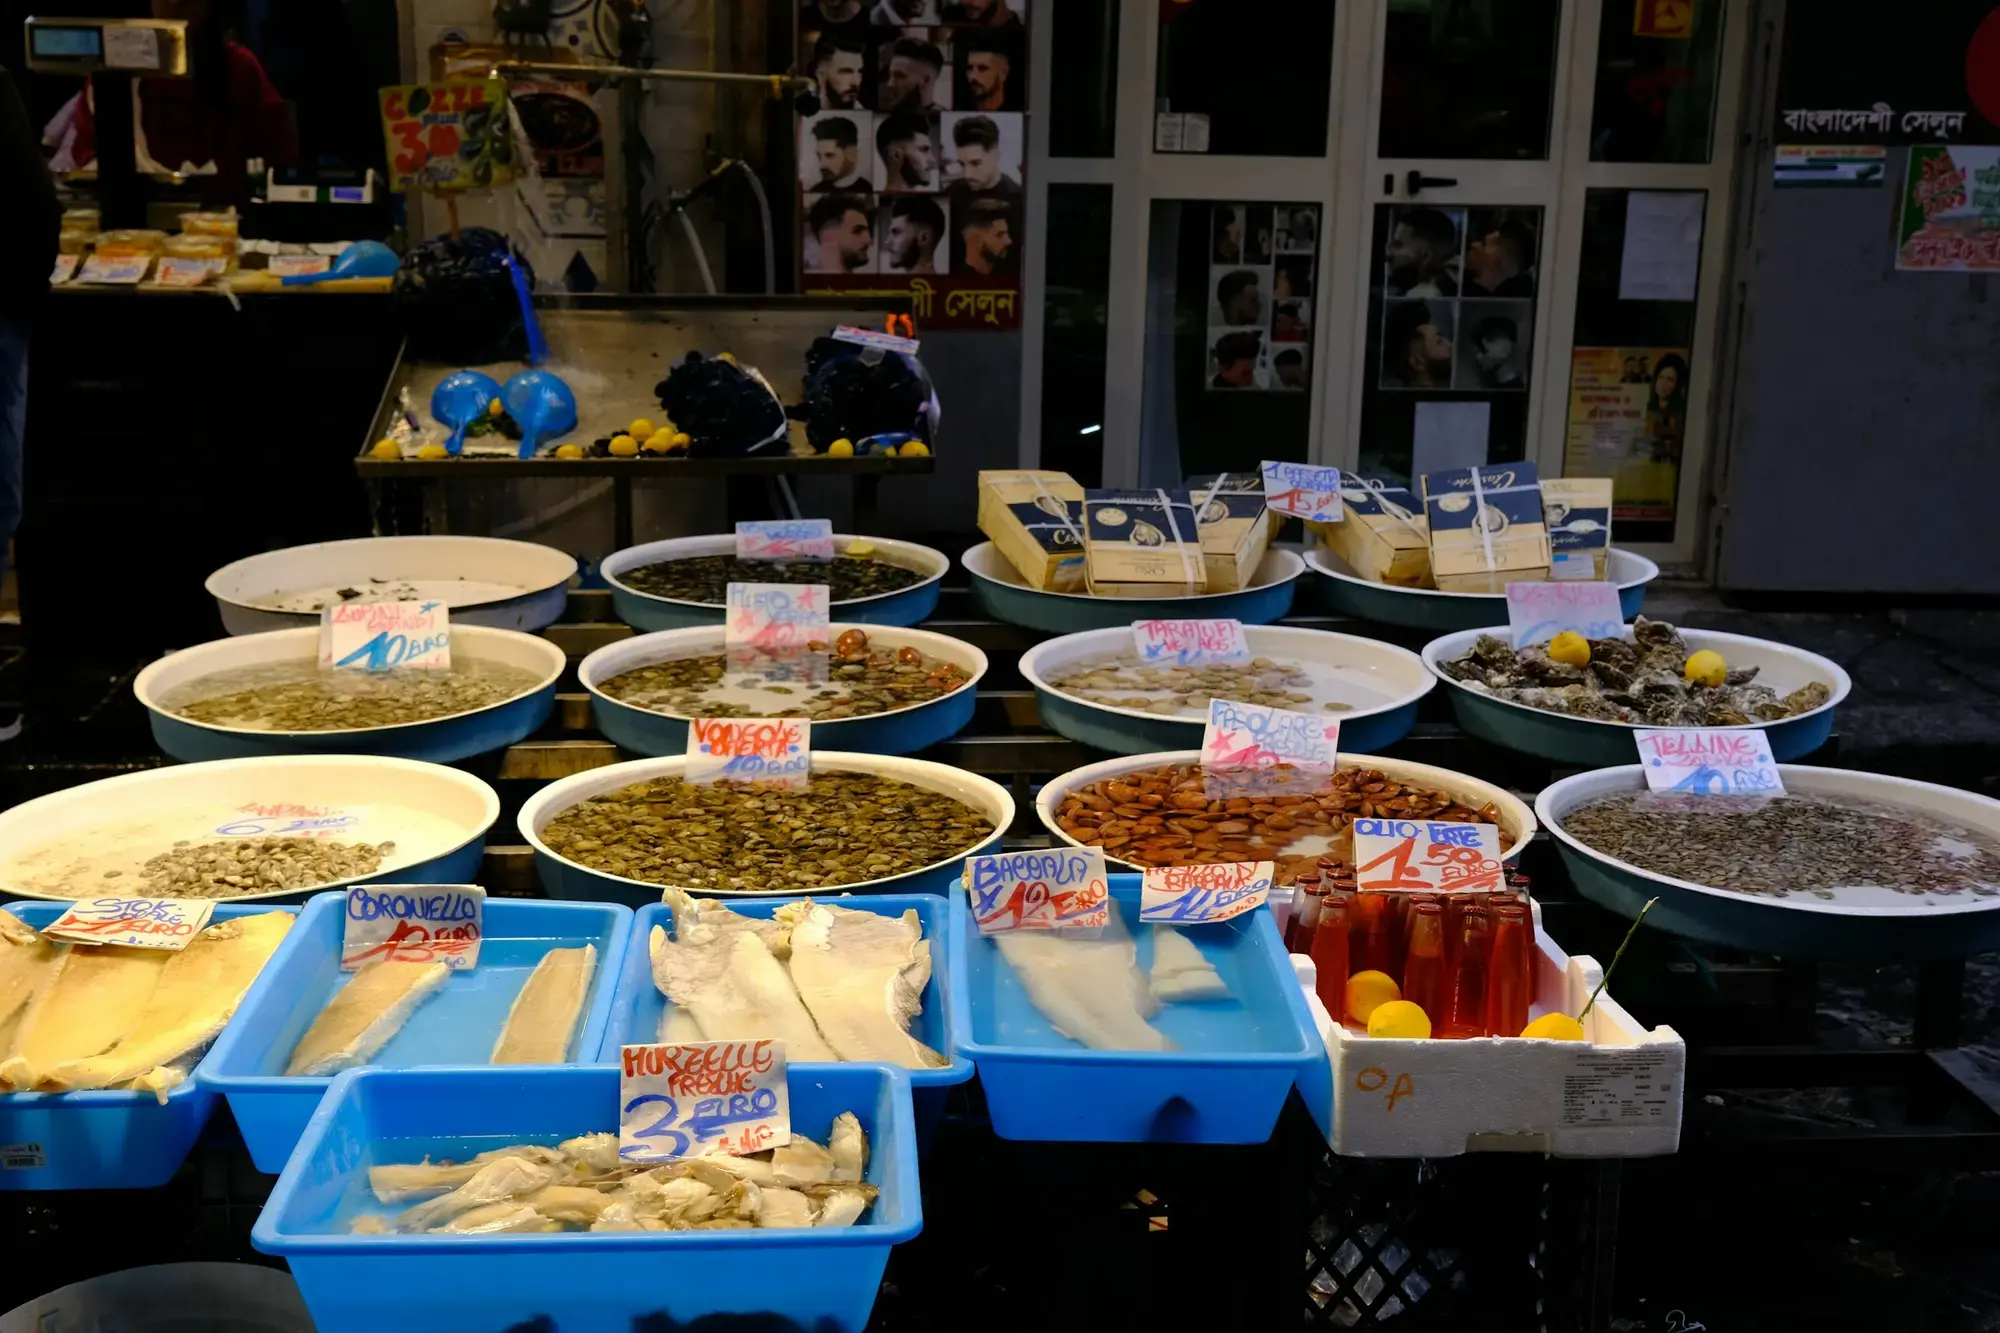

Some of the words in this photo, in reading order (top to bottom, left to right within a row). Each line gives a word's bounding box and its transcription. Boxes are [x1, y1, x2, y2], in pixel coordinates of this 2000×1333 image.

[1783, 101, 1896, 133] বাংলাদেশী
[1901, 110, 1966, 138] সেলুন
[945, 289, 1018, 325] সেলুন
[335, 631, 407, 670] 10
[619, 1093, 691, 1162] 3
